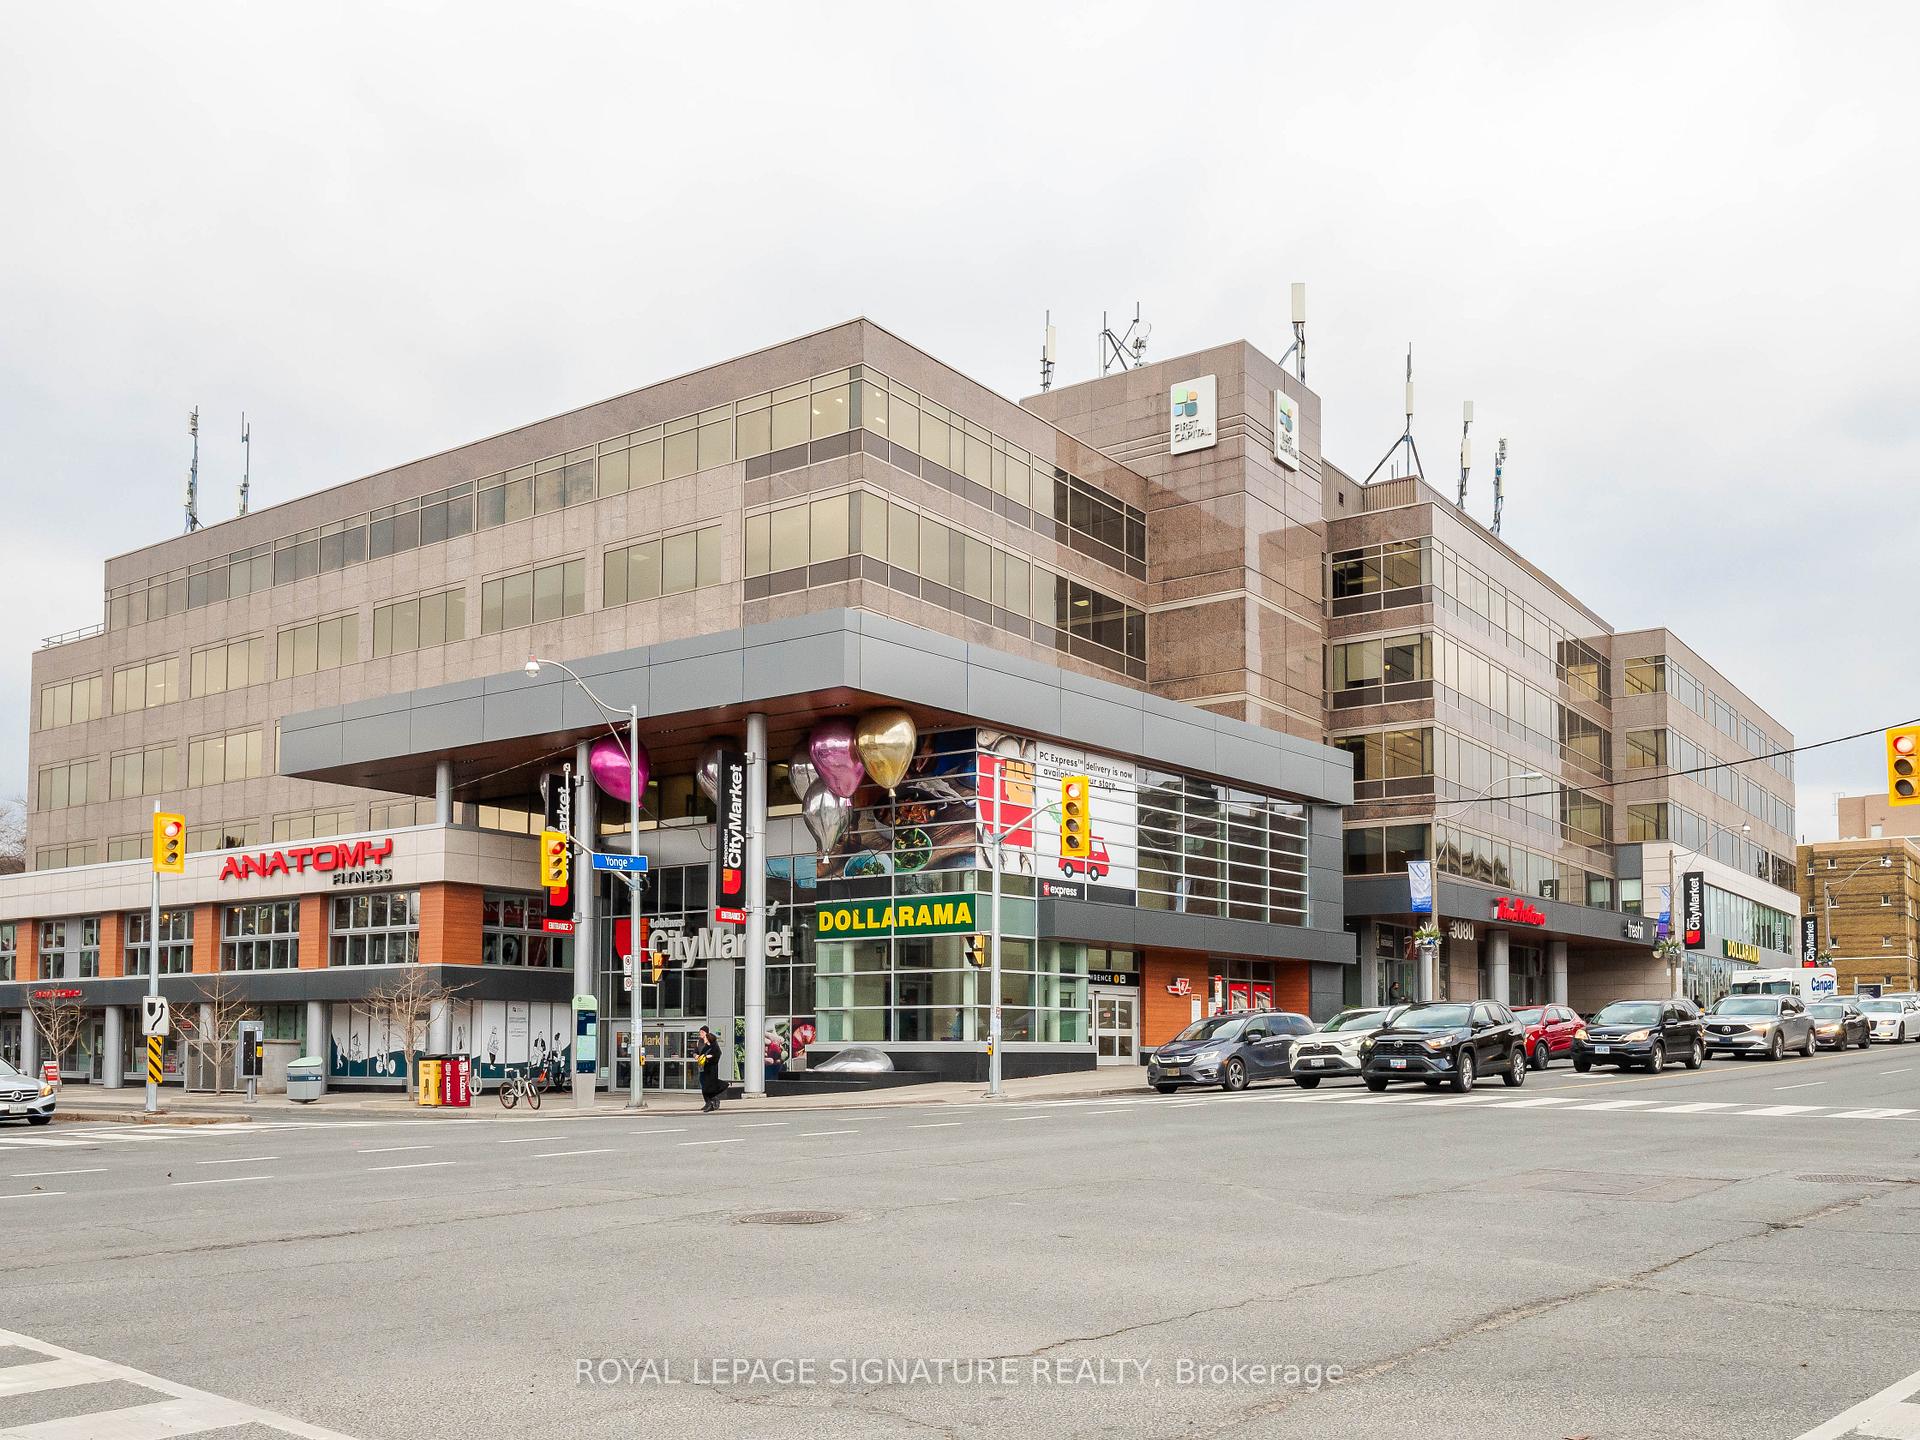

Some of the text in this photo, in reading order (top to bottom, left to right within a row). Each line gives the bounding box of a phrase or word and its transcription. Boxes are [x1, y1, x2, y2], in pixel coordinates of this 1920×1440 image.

[1174, 420, 1199, 433] FIRST
[1174, 428, 1213, 443] CAPITAL
[1039, 751, 1049, 761] PC
[1085, 762, 1112, 775] delivery
[1112, 765, 1119, 777] is
[1119, 770, 1134, 780] now
[728, 764, 745, 868] CityMarket
[219, 838, 393, 881] ANATOMY
[604, 855, 628, 870] Yonge
[332, 868, 393, 886] FITNESS
[1050, 885, 1078, 898] express
[721, 910, 741, 921] ENTRANCE
[1689, 877, 1703, 931] CityMarket
[818, 902, 973, 932] DOLLARAMA
[1450, 920, 1475, 941] 3080
[1806, 920, 1817, 962] CityMarket
[648, 924, 794, 969] CityMaret
[1727, 939, 1760, 964] DOLLARAMA
[1811, 977, 1835, 994] Canpar
